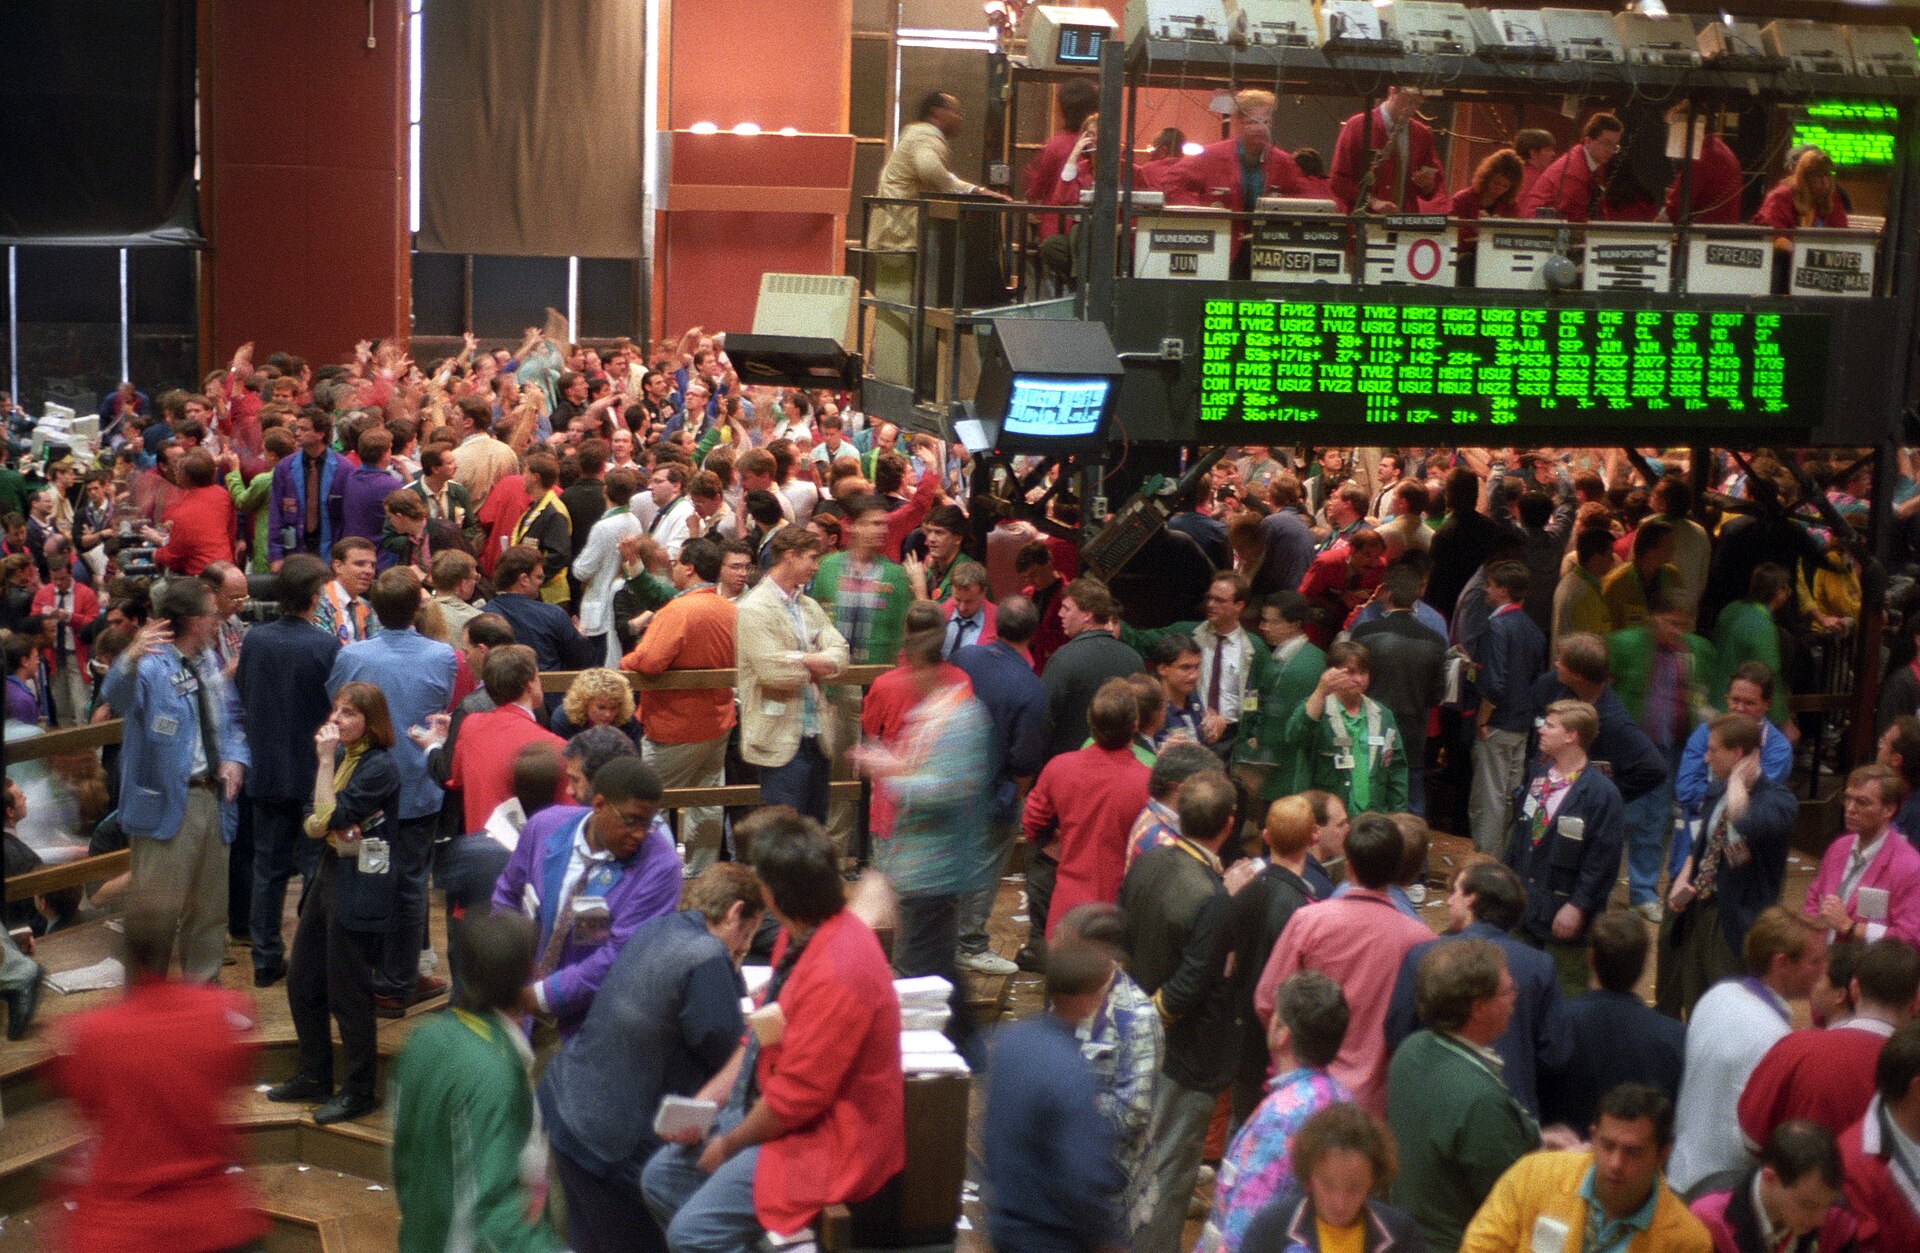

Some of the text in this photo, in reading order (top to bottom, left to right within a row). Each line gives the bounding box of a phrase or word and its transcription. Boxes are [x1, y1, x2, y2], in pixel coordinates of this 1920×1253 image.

[1253, 250, 1282, 266] MAR
[1285, 253, 1311, 269] SEP
[1708, 247, 1762, 265] SPREADS
[1170, 255, 1197, 271] JUN
[1205, 301, 1234, 315] COM
[1205, 317, 1233, 330] COM
[1204, 332, 1240, 345] LAST
[1203, 347, 1231, 360] DIF
[1203, 362, 1231, 375] COM
[1202, 377, 1230, 390] COM
[1201, 392, 1237, 405] LAST
[1201, 407, 1228, 420] DIF
